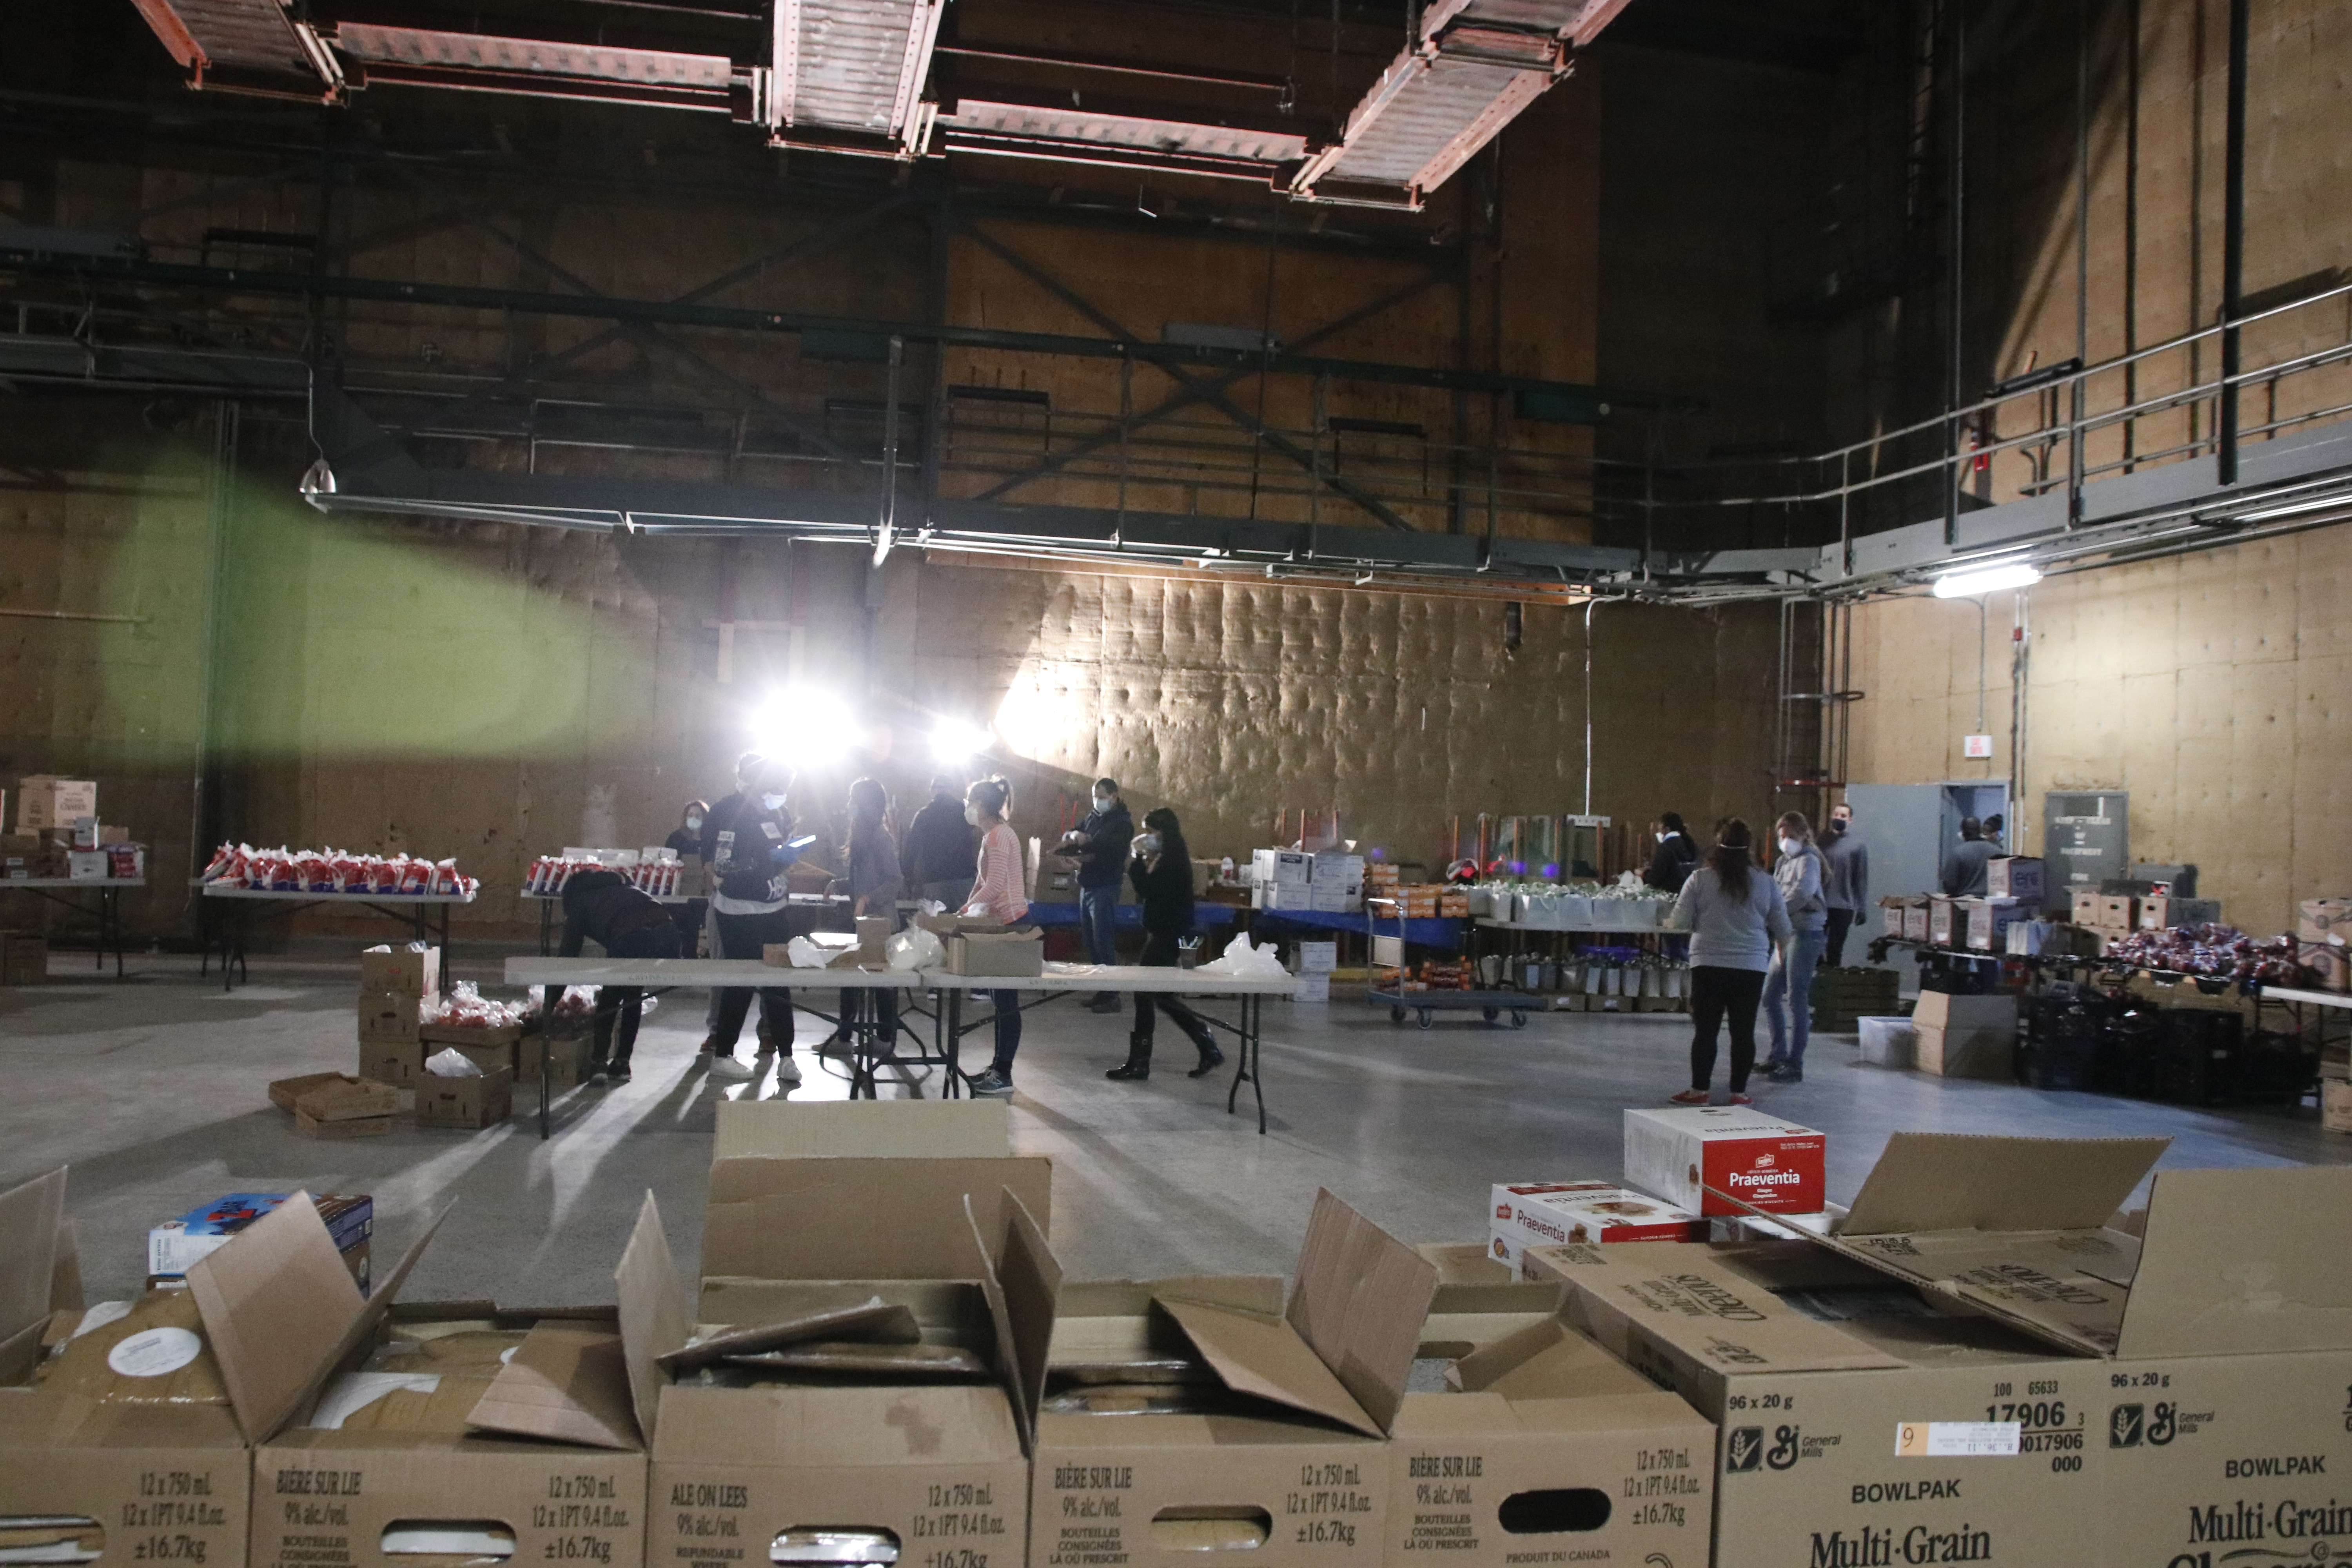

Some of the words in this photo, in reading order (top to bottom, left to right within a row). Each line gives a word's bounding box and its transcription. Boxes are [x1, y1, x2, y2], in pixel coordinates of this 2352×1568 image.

[1730, 1169, 1800, 1187] Praeventia
[1517, 1210, 1565, 1242] Praeventia
[1994, 1382, 2012, 1397] 100
[2029, 1380, 2058, 1395] 65633
[2111, 1374, 2128, 1387] 96
[2131, 1376, 2138, 1387] x
[2142, 1372, 2158, 1386] 20
[2161, 1375, 2170, 1387] g
[1730, 1396, 1746, 1410] 96
[1751, 1398, 1758, 1409] x
[1763, 1394, 1780, 1408] 20
[1784, 1396, 1793, 1410] g
[1986, 1401, 2065, 1428] 17906
[2078, 1412, 2085, 1425] 3
[2179, 1412, 2214, 1423] General
[1903, 1428, 1914, 1448] 9
[2178, 1424, 2198, 1434] Mills
[1803, 1435, 1841, 1446] General
[1637, 1450, 1647, 1470] 12
[1650, 1454, 1655, 1470] x
[1658, 1449, 1674, 1470] 750
[1801, 1447, 1823, 1457] Mills
[1410, 1451, 1441, 1477] BIÈRE
[1443, 1456, 1463, 1477] SUR
[1466, 1456, 1482, 1477] LIE
[2052, 1455, 2082, 1472] 000
[2225, 1455, 2325, 1478] BOWLPAK
[1055, 1461, 1087, 1489] BIÈRE
[1090, 1467, 1111, 1488] SUR
[1115, 1467, 1132, 1488] LIE
[1302, 1464, 1313, 1486] 12
[1315, 1470, 1321, 1485] x
[1324, 1464, 1342, 1485] 750
[549, 1475, 562, 1498] 12
[564, 1482, 572, 1497] x
[575, 1475, 595, 1498] 750
[671, 1484, 694, 1505] ALE
[697, 1485, 716, 1507] ON
[719, 1485, 748, 1508] LEES
[928, 1485, 940, 1507] 12
[944, 1490, 950, 1507] x
[954, 1483, 973, 1505] 750
[1417, 1484, 1431, 1504] 9%
[1624, 1477, 1634, 1497] 12
[1636, 1481, 1642, 1497] x
[1646, 1475, 1662, 1496] 1PT
[1664, 1475, 1677, 1494] 9.4
[1852, 1479, 1961, 1503] BOWLPAK
[1063, 1496, 1077, 1517] 9%
[1287, 1493, 1298, 1514] 12
[1301, 1498, 1308, 1513] x
[1311, 1492, 1329, 1513] 1PT
[1332, 1492, 1346, 1512] 9.4
[533, 1505, 545, 1527] 12
[549, 1510, 555, 1527] x
[1415, 1514, 1470, 1524] BOUTEILLES
[1633, 1503, 1685, 1526] ±16.7kg
[913, 1515, 925, 1537] 12
[928, 1520, 935, 1536] x
[939, 1514, 958, 1536] 1PT
[1061, 1528, 1120, 1538] BOUTEILLES
[1297, 1520, 1355, 1546] ±16.7kg
[1412, 1526, 1472, 1537] CONSIGNÉES
[545, 1536, 612, 1564] ±16.7kg
[1436, 1539, 1479, 1549] PRESCRIT
[1506, 1552, 1550, 1564] PRODUIT
[1552, 1552, 1566, 1561] DU
[1569, 1550, 1610, 1561] CANADA
